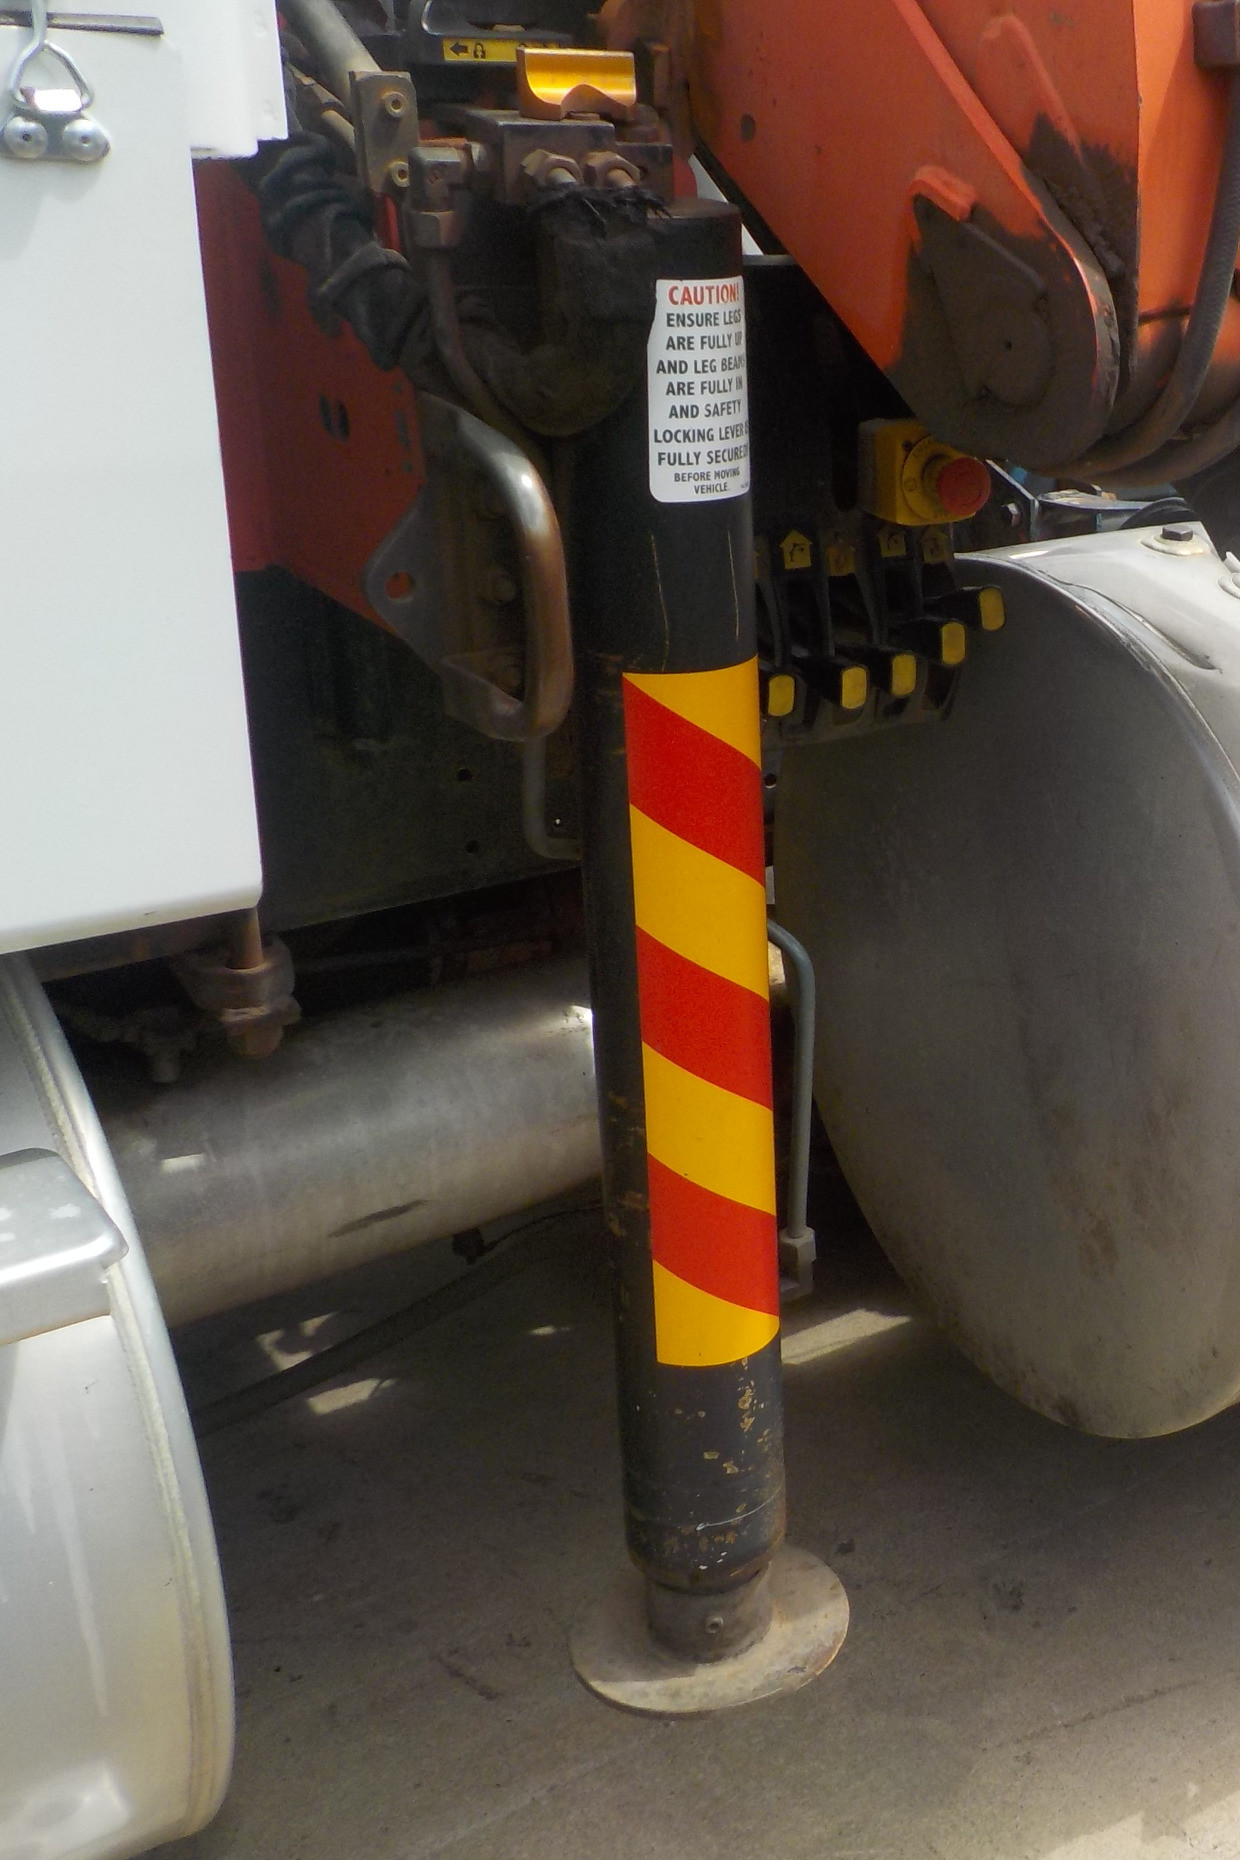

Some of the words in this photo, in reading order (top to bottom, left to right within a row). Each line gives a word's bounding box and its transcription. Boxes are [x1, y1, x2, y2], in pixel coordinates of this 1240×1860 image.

[668, 283, 739, 306] CAUTION!
[666, 311, 720, 328] ENSURE
[723, 309, 742, 326] LEGS
[665, 335, 695, 351] ARE
[700, 333, 732, 350] FULLY
[734, 331, 742, 346] UP
[656, 359, 688, 375] AND
[694, 358, 717, 374] LEG
[665, 381, 695, 396] ARE
[700, 377, 733, 395] FULLY
[735, 375, 743, 390] IN
[668, 404, 700, 419] AND
[704, 399, 741, 418] SAFETY
[653, 428, 714, 443] LOCKING
[719, 423, 744, 441] LEVER
[657, 451, 701, 467] FULLY
[674, 471, 711, 482] BEFORE
[714, 466, 740, 480] MOVING
